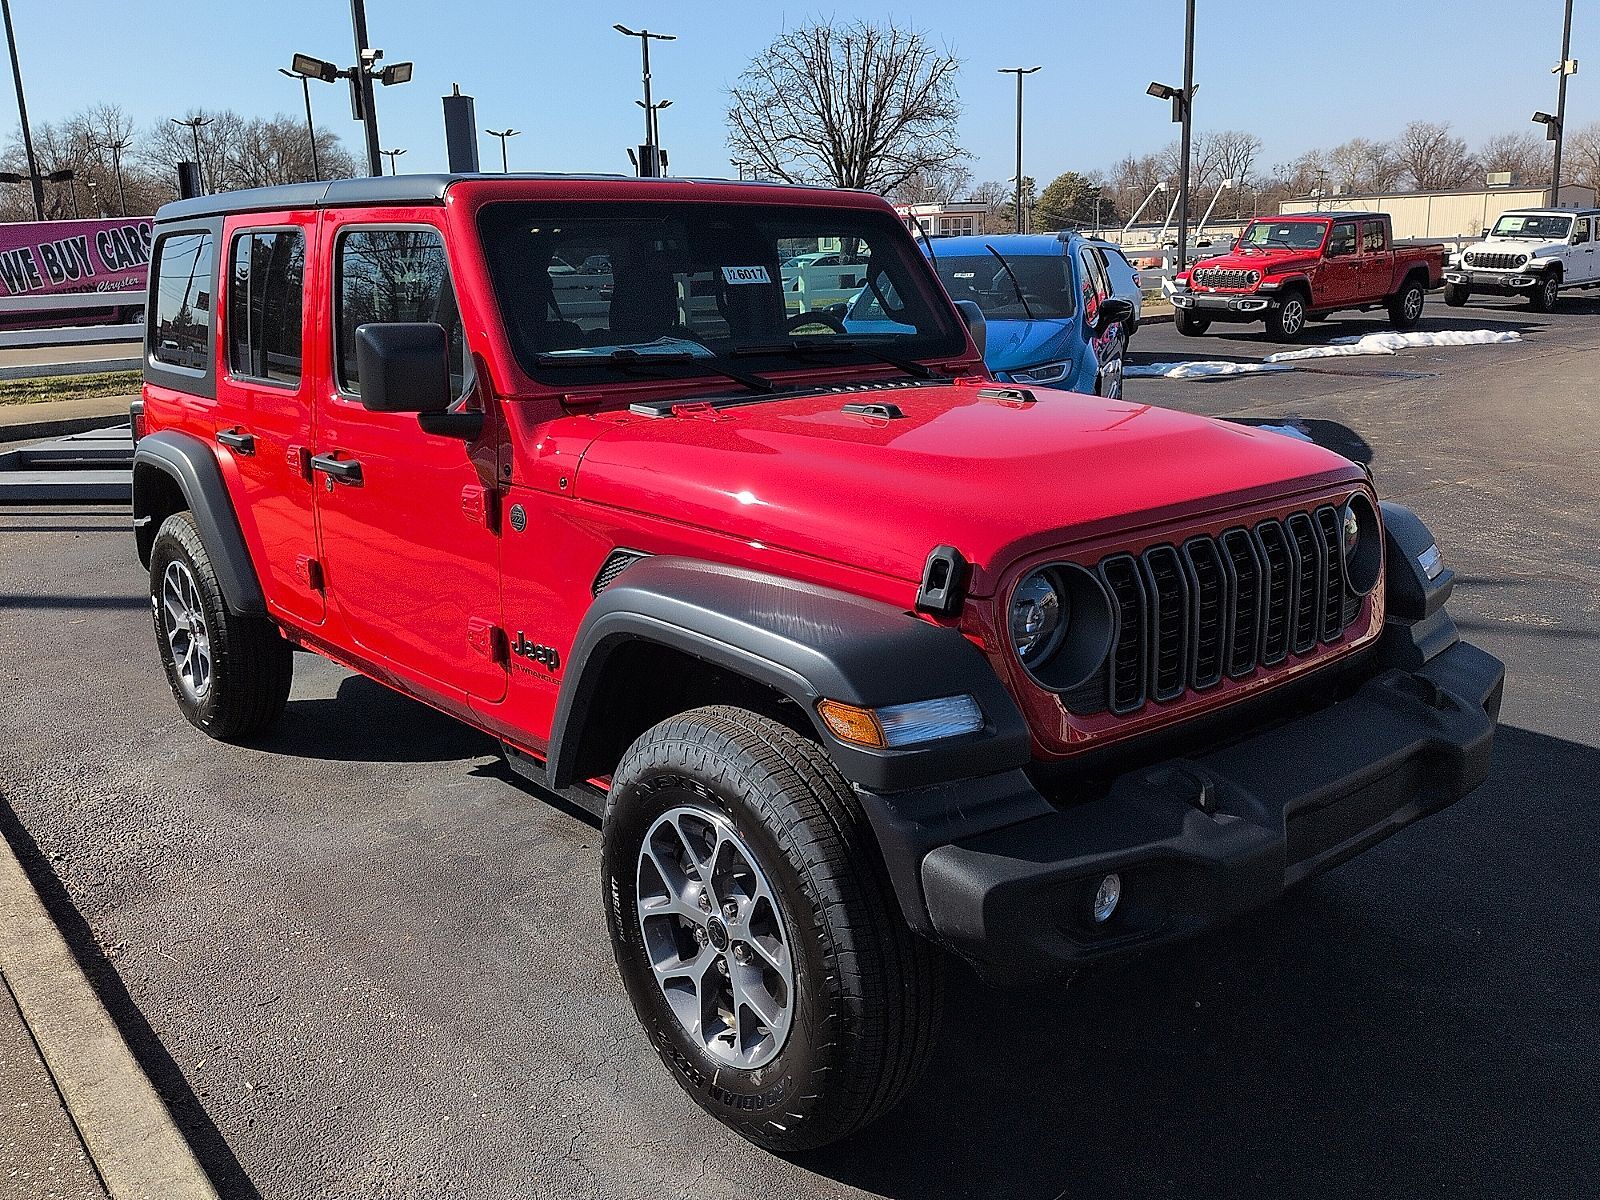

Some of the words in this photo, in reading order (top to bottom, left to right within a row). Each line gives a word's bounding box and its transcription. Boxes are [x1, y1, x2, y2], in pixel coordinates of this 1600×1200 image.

[0, 247, 44, 295] WE
[38, 235, 95, 285] BUY
[96, 222, 151, 272] CARS
[96, 276, 139, 293] Chrysler
[511, 629, 561, 673] Jeep
